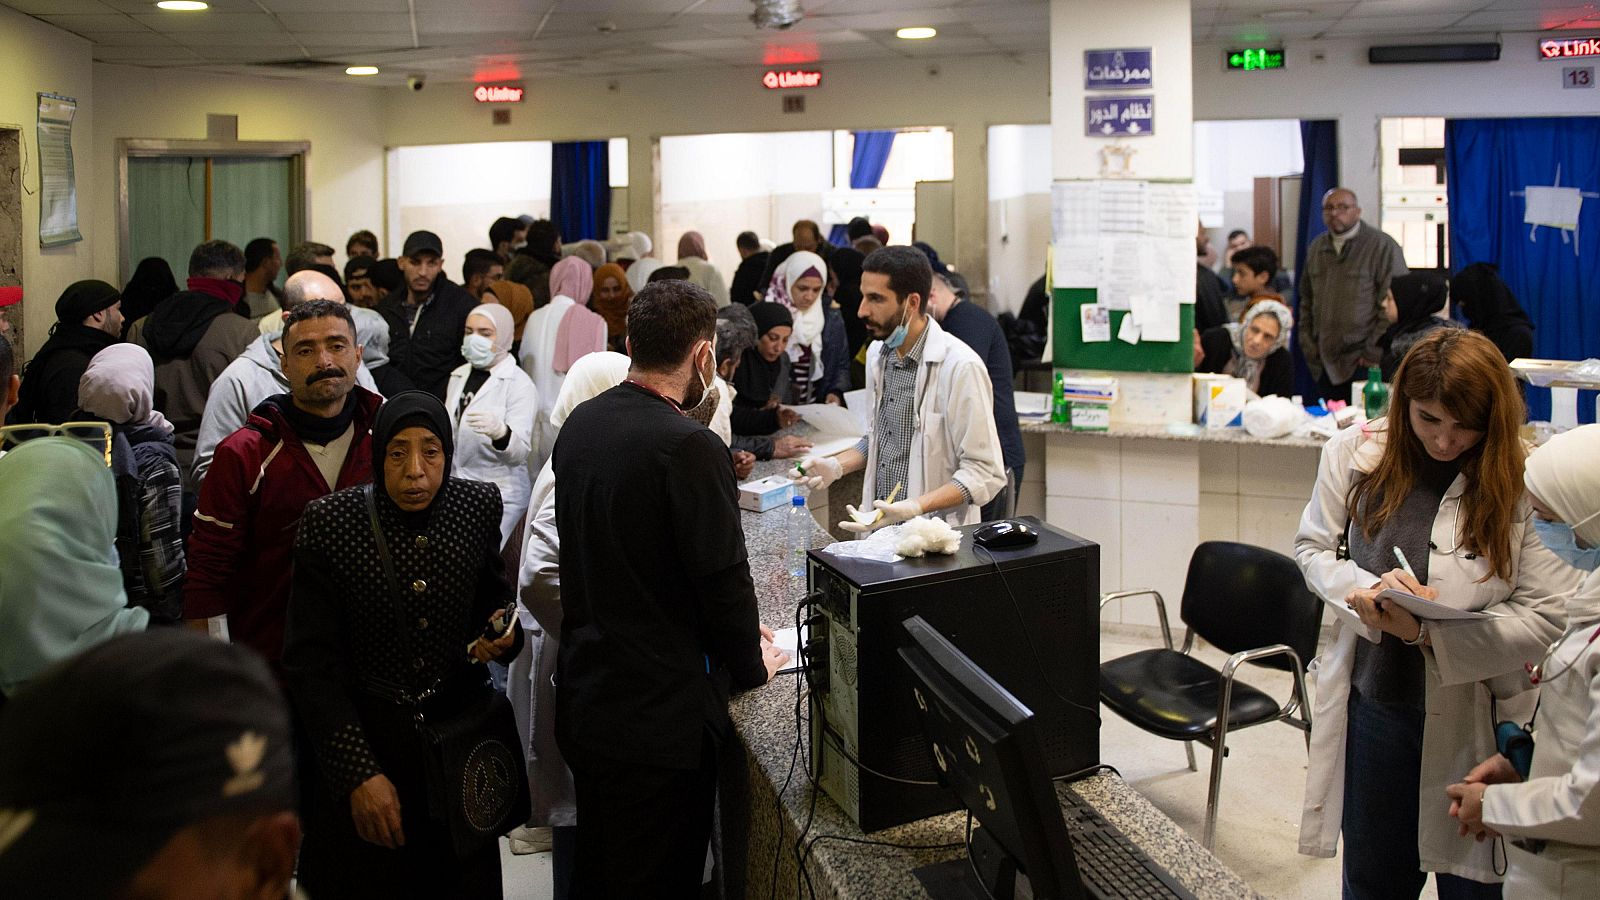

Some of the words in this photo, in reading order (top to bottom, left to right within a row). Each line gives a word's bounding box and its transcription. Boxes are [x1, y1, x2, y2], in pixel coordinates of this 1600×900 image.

[1089, 66, 1150, 83] ممرضات
[1568, 70, 1590, 85] 13
[1090, 104, 1118, 124] الدور
[1120, 103, 1152, 124] نظام
